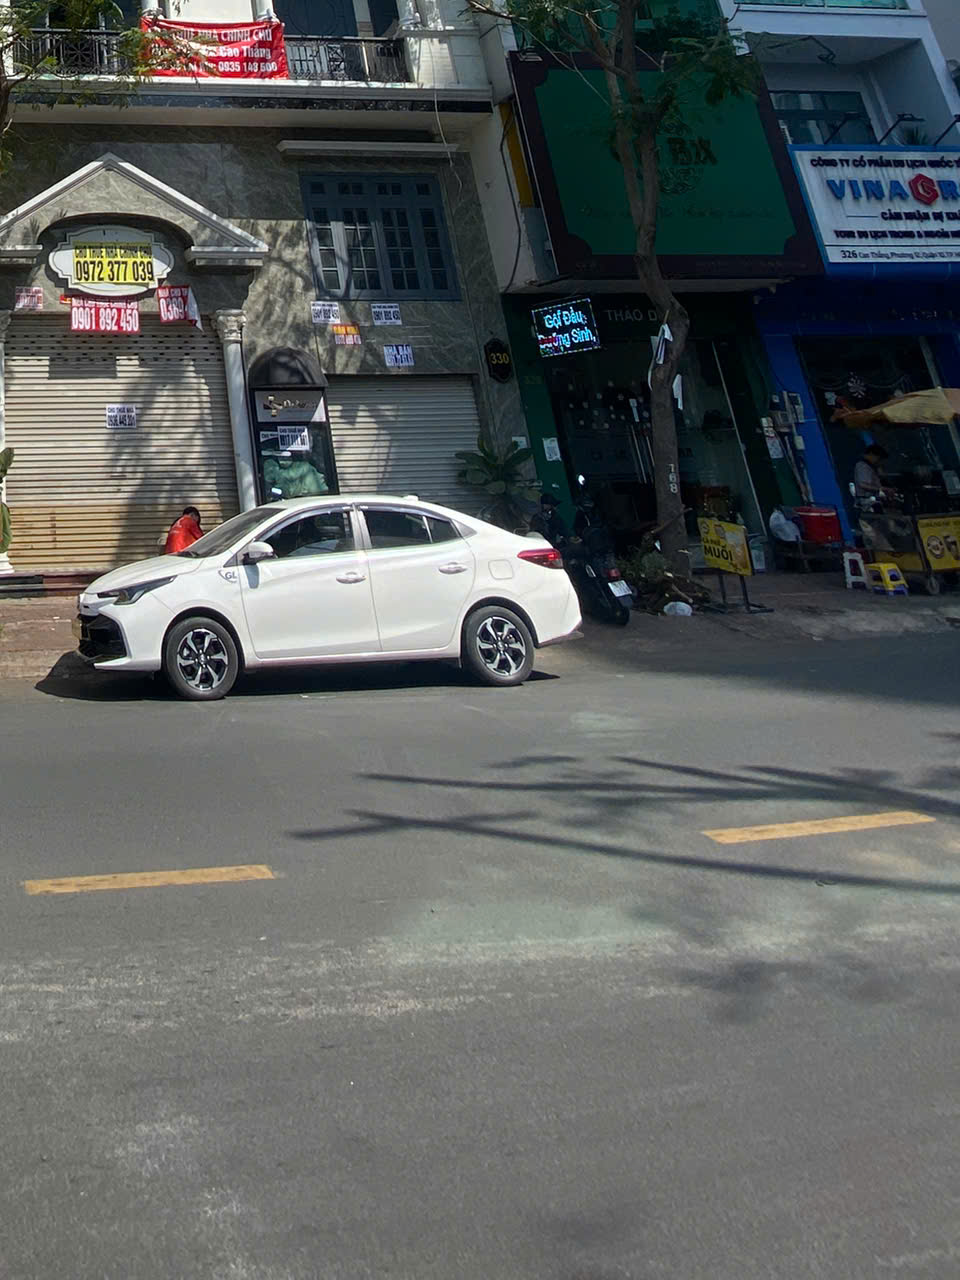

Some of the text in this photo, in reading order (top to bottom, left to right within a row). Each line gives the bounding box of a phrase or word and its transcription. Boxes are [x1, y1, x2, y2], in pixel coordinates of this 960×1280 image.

[219, 46, 239, 58] Cao
[826, 173, 960, 206] VINAGR
[841, 250, 858, 258] 326
[75, 260, 154, 281] 0972 377 039
[71, 307, 139, 332] 0901 892 450
[490, 352, 510, 365] 330
[225, 571, 238, 580] GL
